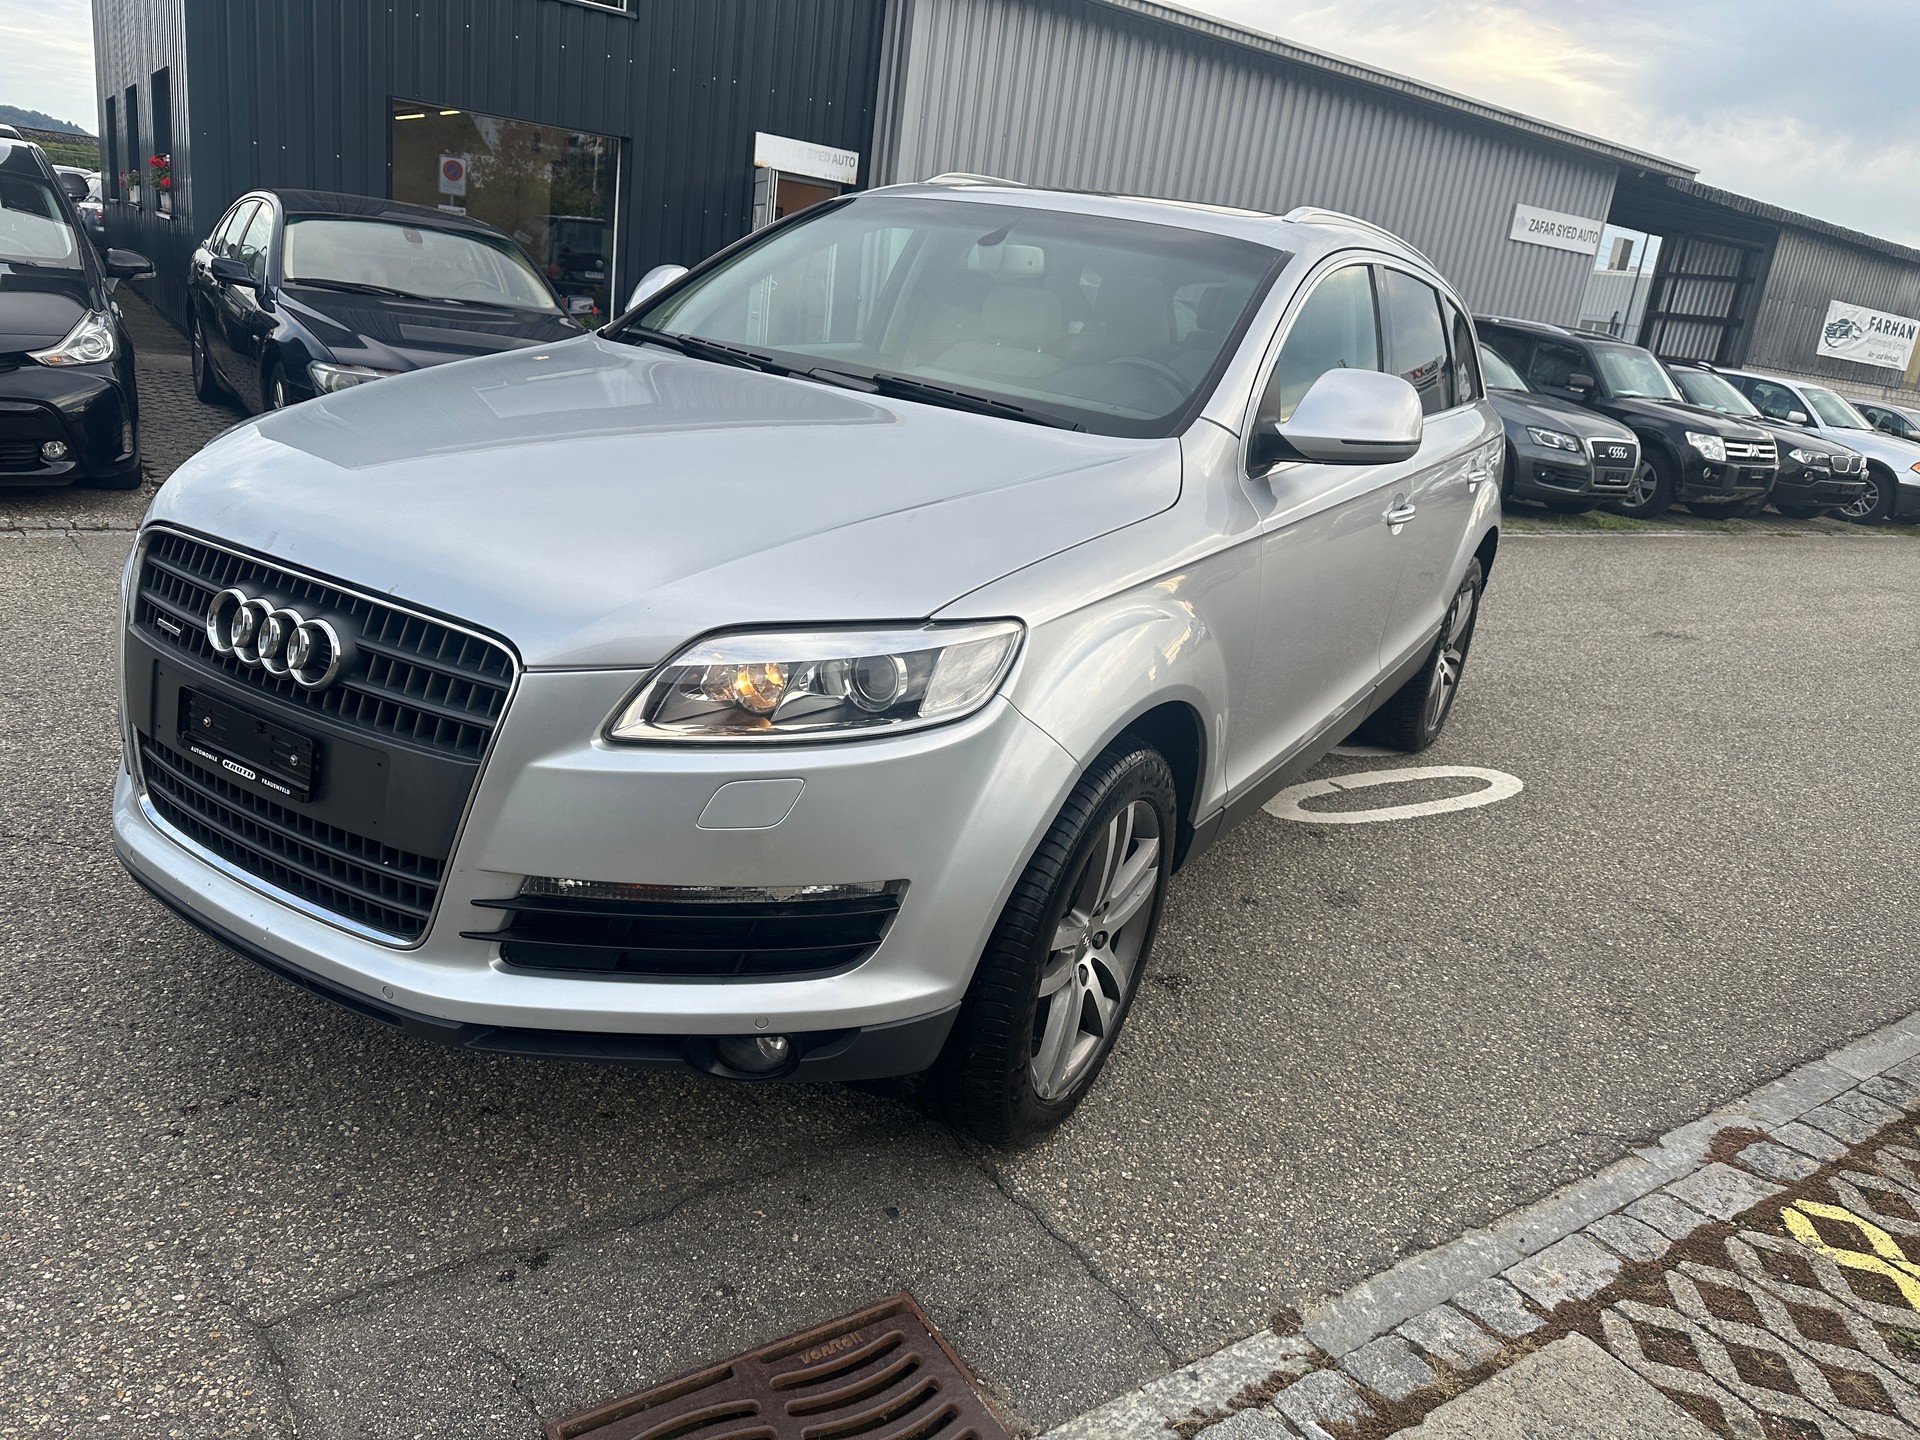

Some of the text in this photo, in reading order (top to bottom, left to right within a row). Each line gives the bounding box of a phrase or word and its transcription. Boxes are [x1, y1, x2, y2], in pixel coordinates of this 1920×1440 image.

[831, 153, 856, 168] AUTO
[1528, 219, 1599, 244] ZAFAR SYED AUTO
[1868, 316, 1916, 340] FARHAN
[190, 746, 218, 762] AUTOMOBILE
